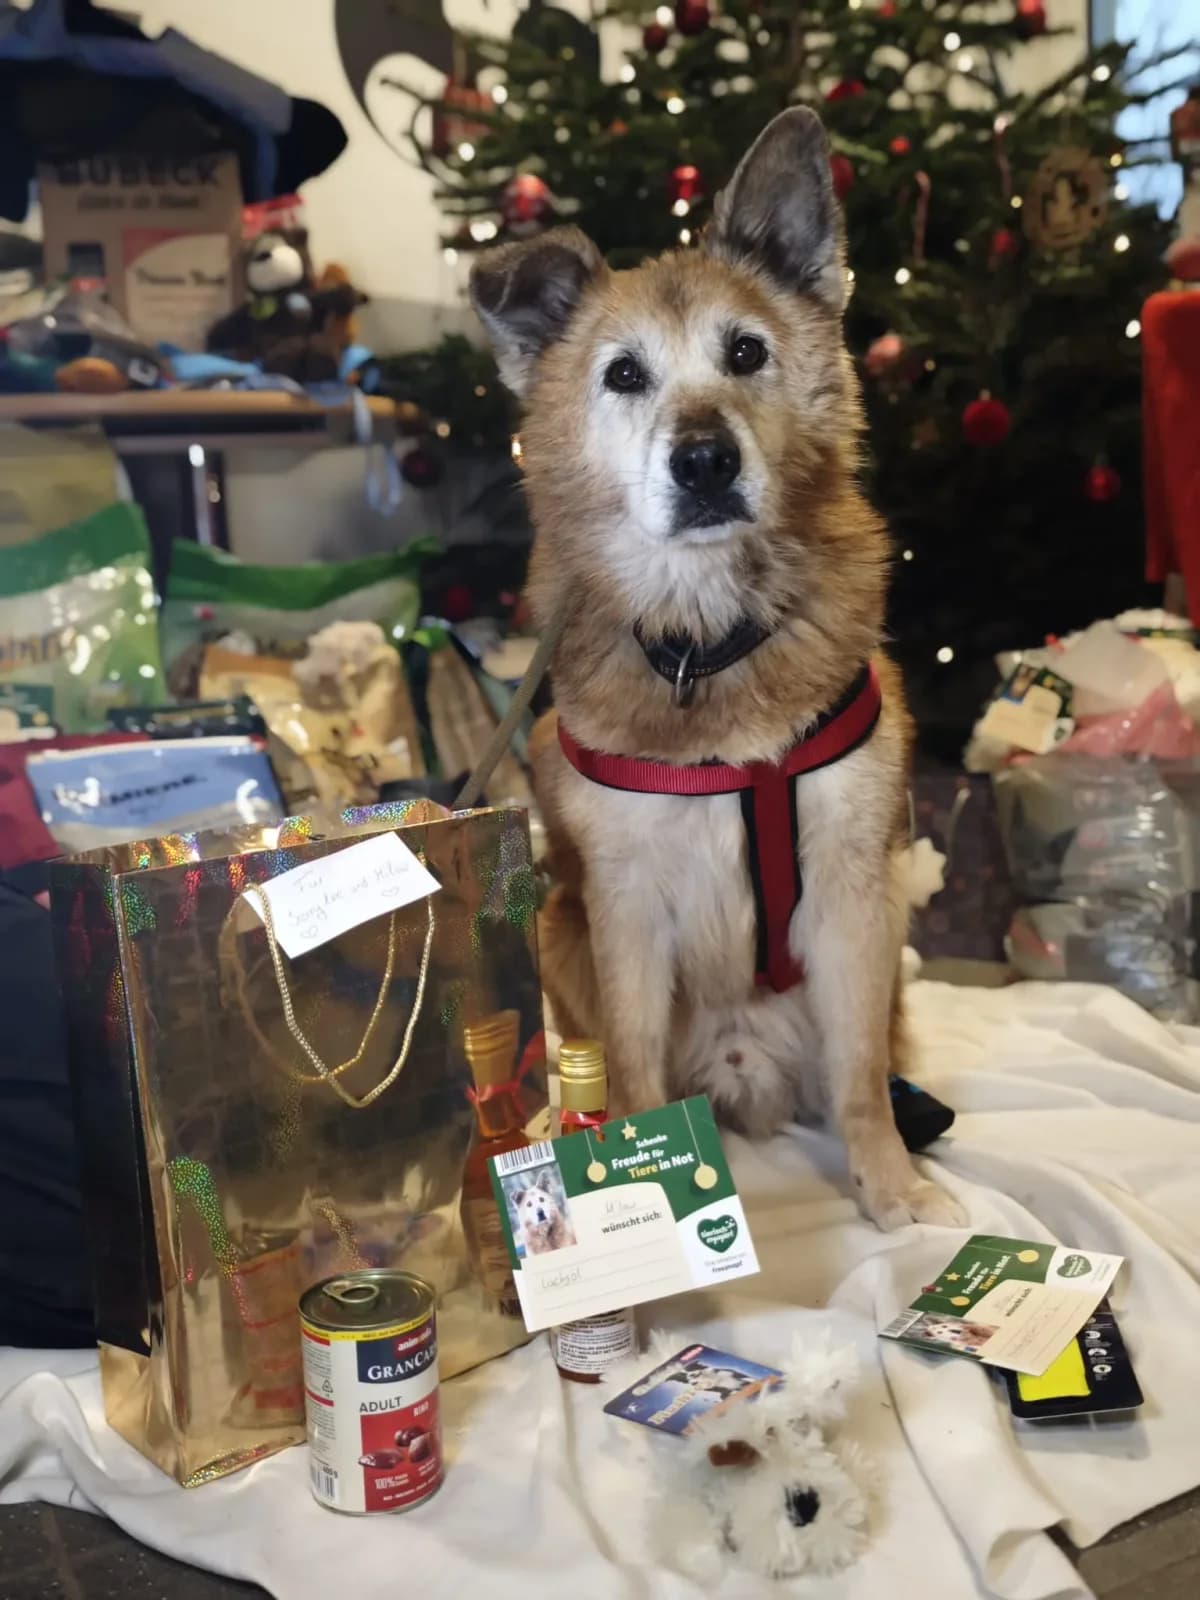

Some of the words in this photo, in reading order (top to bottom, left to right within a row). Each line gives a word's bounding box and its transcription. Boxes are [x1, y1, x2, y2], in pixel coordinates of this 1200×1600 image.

[635, 1133, 668, 1149] Schenke
[611, 1150, 651, 1171] Freude
[651, 1149, 665, 1159] für
[627, 1163, 658, 1179] Tiere
[658, 1159, 671, 1171] in
[671, 1151, 695, 1167] Not
[601, 1215, 643, 1234] wünscht
[643, 1209, 663, 1222] sich:
[359, 1395, 402, 1413] ADULT
